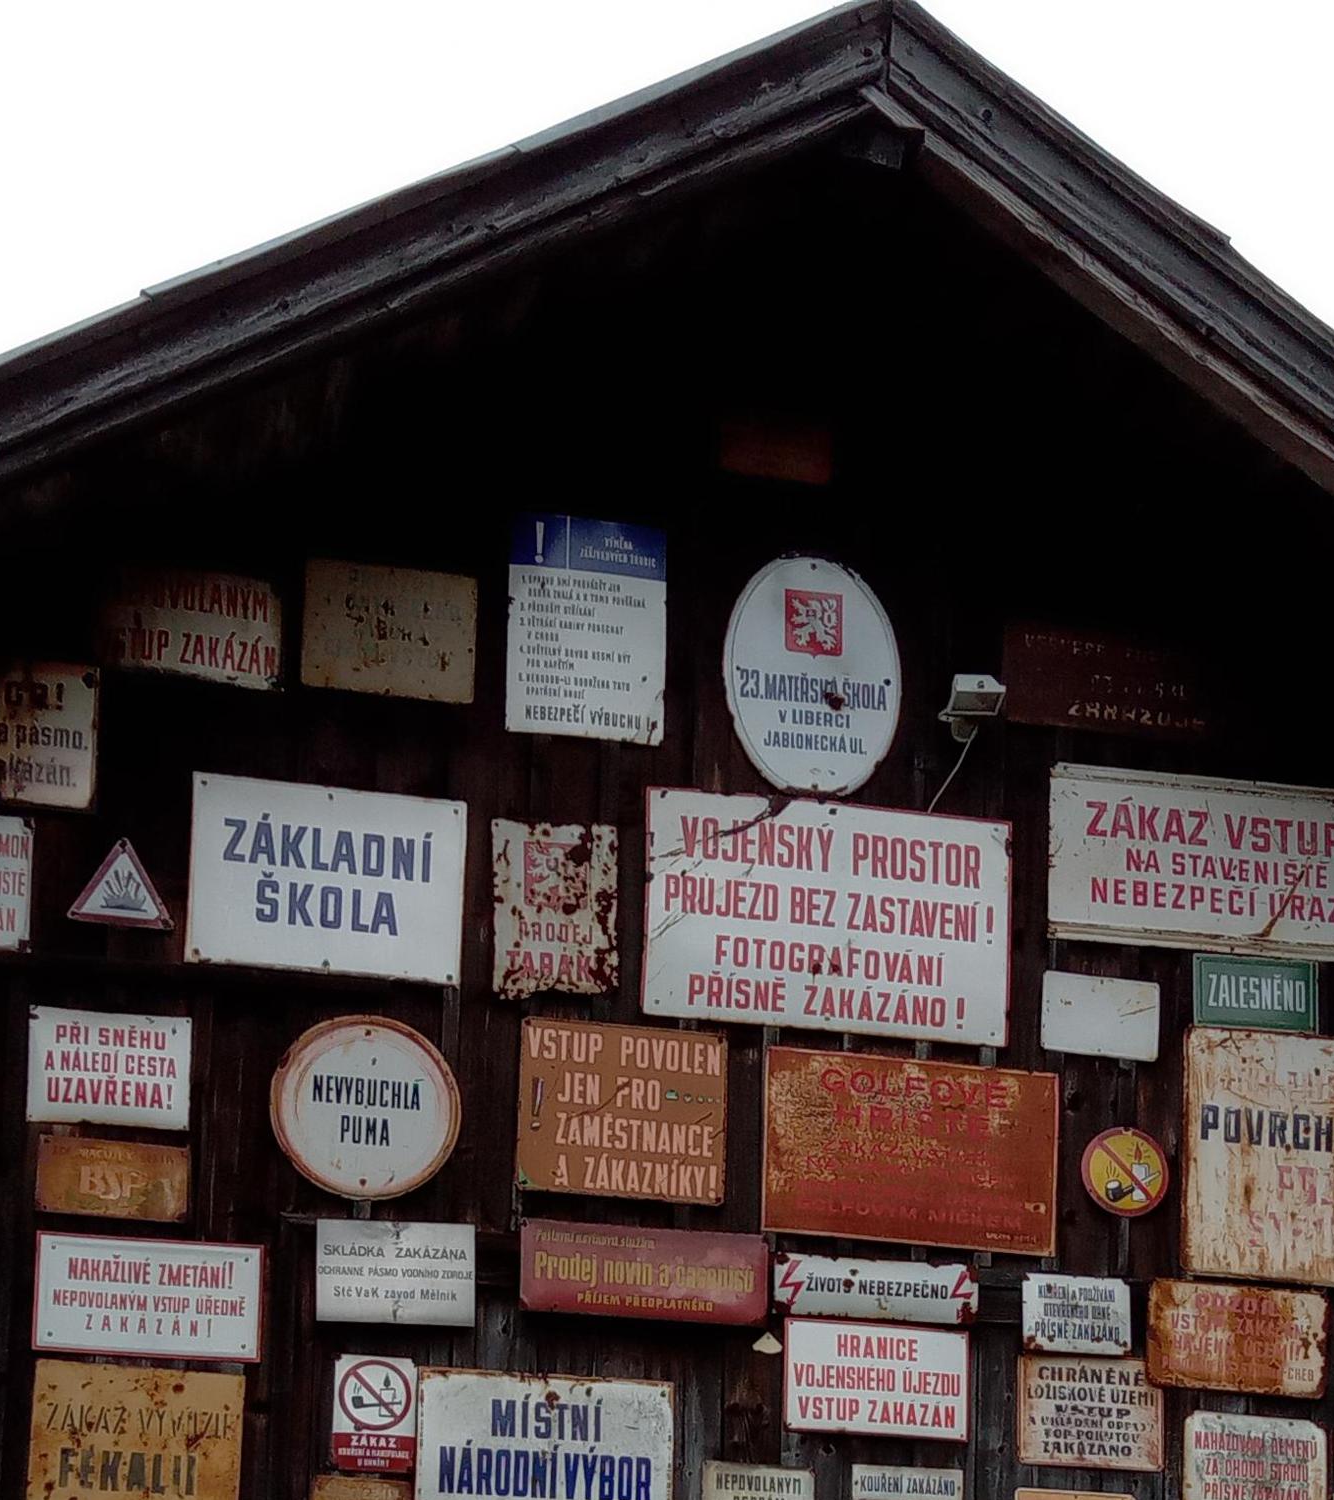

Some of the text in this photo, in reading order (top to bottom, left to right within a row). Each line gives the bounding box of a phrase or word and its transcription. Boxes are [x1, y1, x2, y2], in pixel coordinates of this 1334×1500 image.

[525, 704, 641, 730] NEBEZPEČÍ VÝBUCHU
[778, 709, 850, 729] V LIBERCI
[763, 730, 867, 755] JABLONECKÁ UL.
[1086, 795, 1208, 846] ZÁKAZ
[223, 814, 433, 883] ZÁKLADNÍ
[680, 814, 980, 889] VOJENSKÝ PROSTOR
[1125, 848, 1327, 889] NA STAVENIŠTĚ
[255, 873, 398, 936] ŠKOLA
[664, 872, 778, 921] PRŮJEZD
[790, 885, 834, 927] BEZ
[1091, 877, 1258, 918] NEBEZPEČÍ
[715, 935, 944, 987] FOTOGRAFOVÁNÍ
[689, 974, 786, 1013] PŘÍSNĚ
[1208, 973, 1306, 1015] ZALESNĚNO
[55, 1022, 167, 1049] PŘI SNĚHU
[528, 1027, 721, 1076] VSTUP POVOLEN
[45, 1051, 176, 1078] A NÁLEDÍ CESTA
[47, 1077, 173, 1109] UZAVŘENA!
[313, 1073, 421, 1111] NEVYBUCHLÁ
[557, 1070, 660, 1112] JEN PRO
[340, 1117, 391, 1147] PUMA
[556, 1111, 713, 1158] ZAMĚSTNANCE
[554, 1154, 718, 1198] A ZÁKAZNÍKY!
[68, 1255, 152, 1285] NAKAŽLIVÉ
[322, 1241, 468, 1262] SKLÁDKA ZAKÁZÁNA
[52, 1286, 246, 1317] NEPOVOLANÝM VSTUP ÚŘEDNĚ
[577, 1291, 621, 1306] PŘÍJEM
[837, 1334, 918, 1362] HRANICE
[793, 1361, 961, 1396] VOJENSKÉHO ÚJEZDU
[491, 1396, 603, 1442] MÍSTNÍ
[798, 1395, 956, 1429] VSTUP ZAKÁZÁN
[351, 1434, 397, 1448] ZÁKAZ
[439, 1441, 556, 1500] NÁRODNÍ
[859, 1472, 956, 1497] KOUŘENÍ ZAKÁZÁNO
